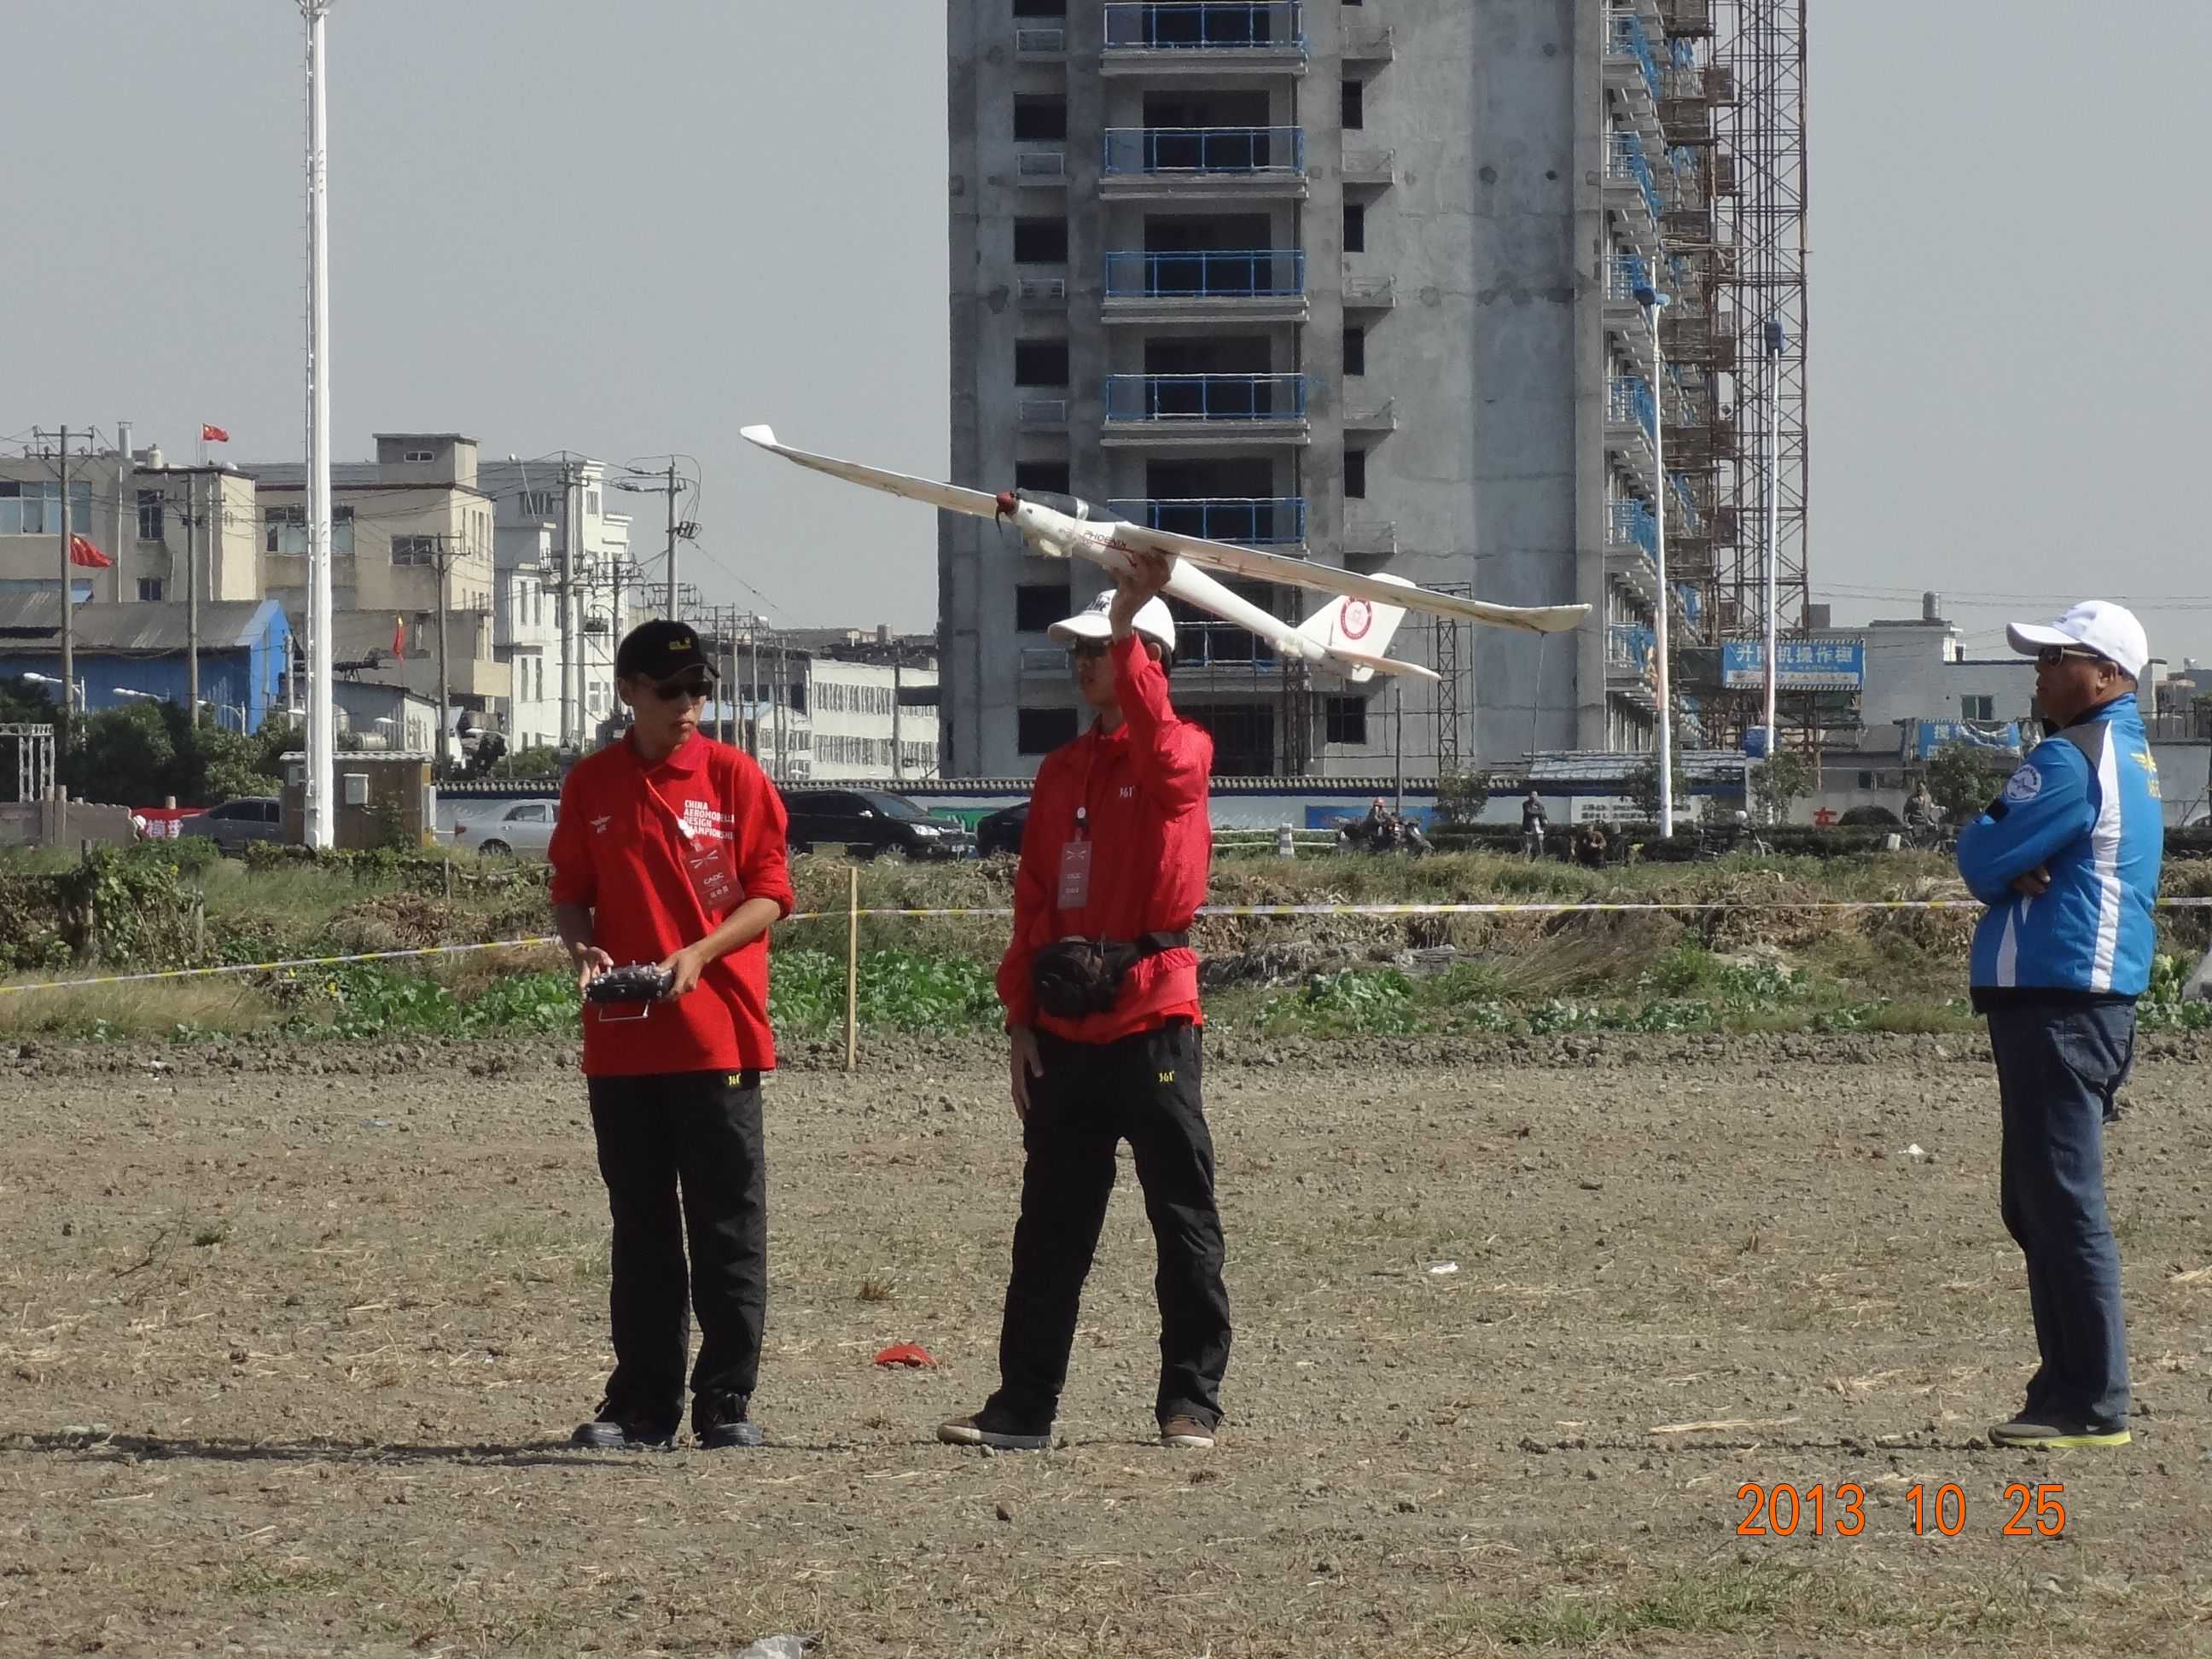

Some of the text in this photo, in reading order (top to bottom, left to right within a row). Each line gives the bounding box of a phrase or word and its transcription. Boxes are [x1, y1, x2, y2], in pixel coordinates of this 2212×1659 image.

[1083, 529, 1127, 549] PHOENIX
[684, 799, 709, 810] CHINA
[684, 816, 713, 828] DESIGN
